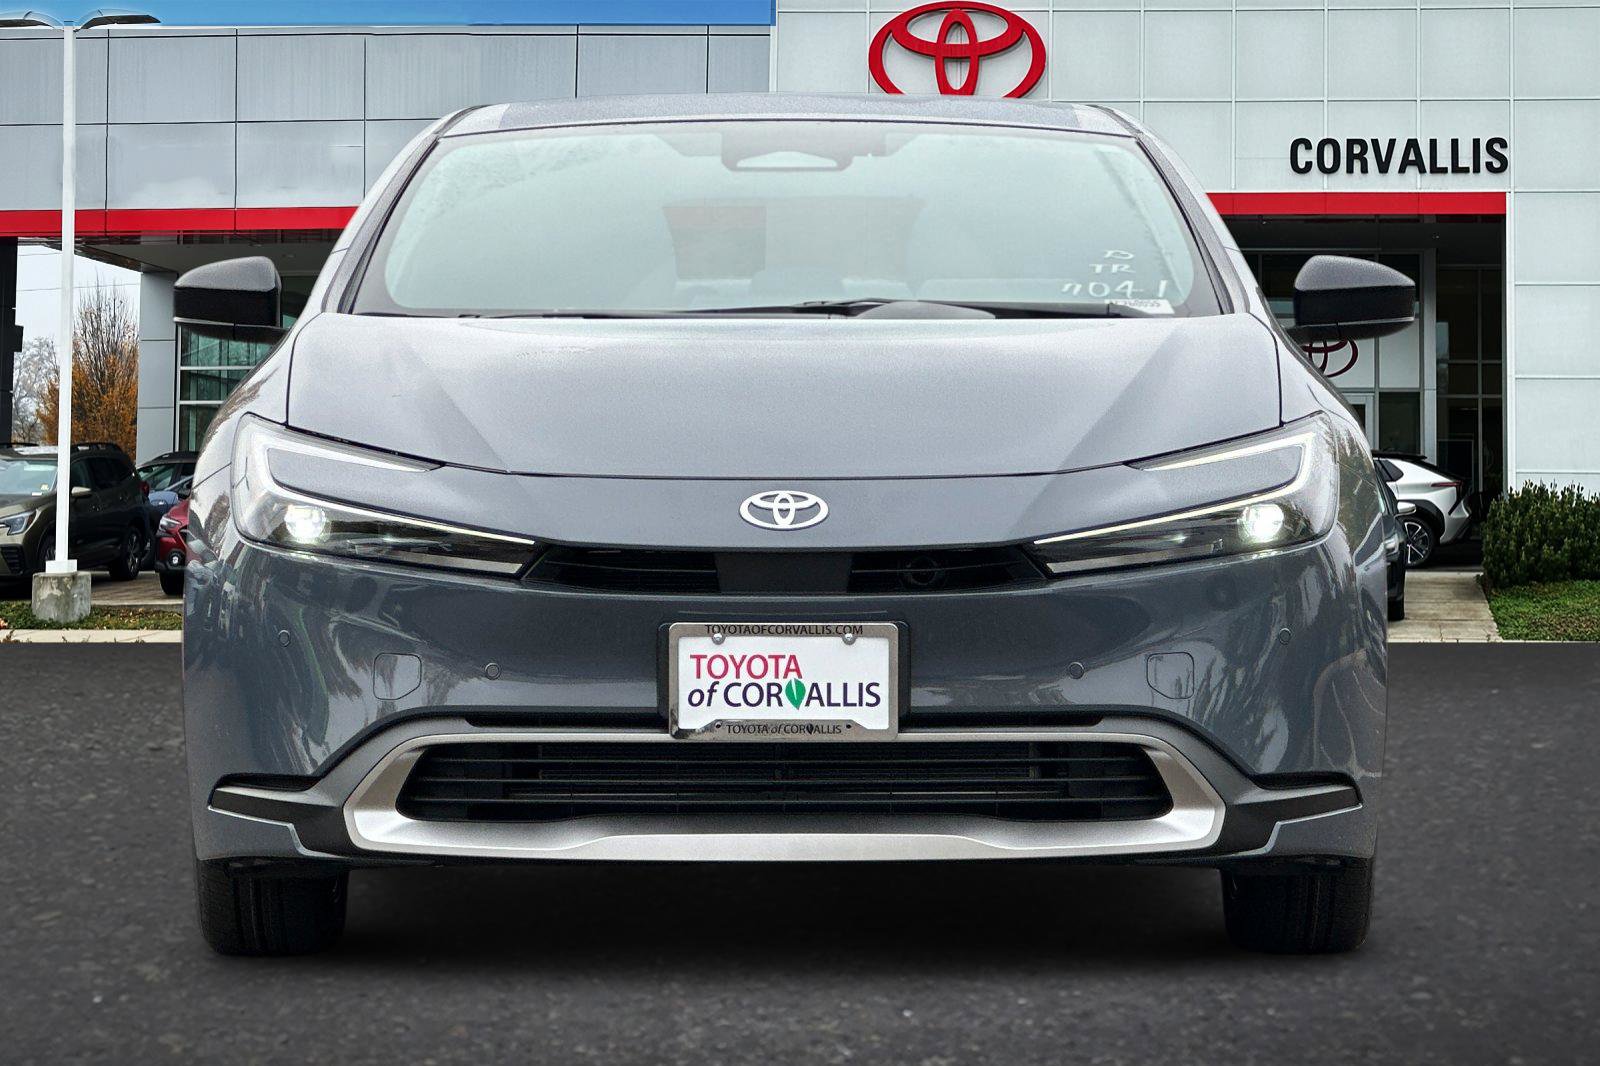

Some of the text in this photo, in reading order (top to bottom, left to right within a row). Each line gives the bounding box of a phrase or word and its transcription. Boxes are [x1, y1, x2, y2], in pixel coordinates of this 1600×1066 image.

[1289, 137, 1509, 174] CORVALLIS
[705, 624, 863, 635] TOYOTAOFCORVALLIS.COM
[689, 654, 803, 679] TOYOTA
[687, 680, 881, 709] of CORVALLIS
[726, 724, 769, 735] TOYOTA
[770, 723, 784, 735] of
